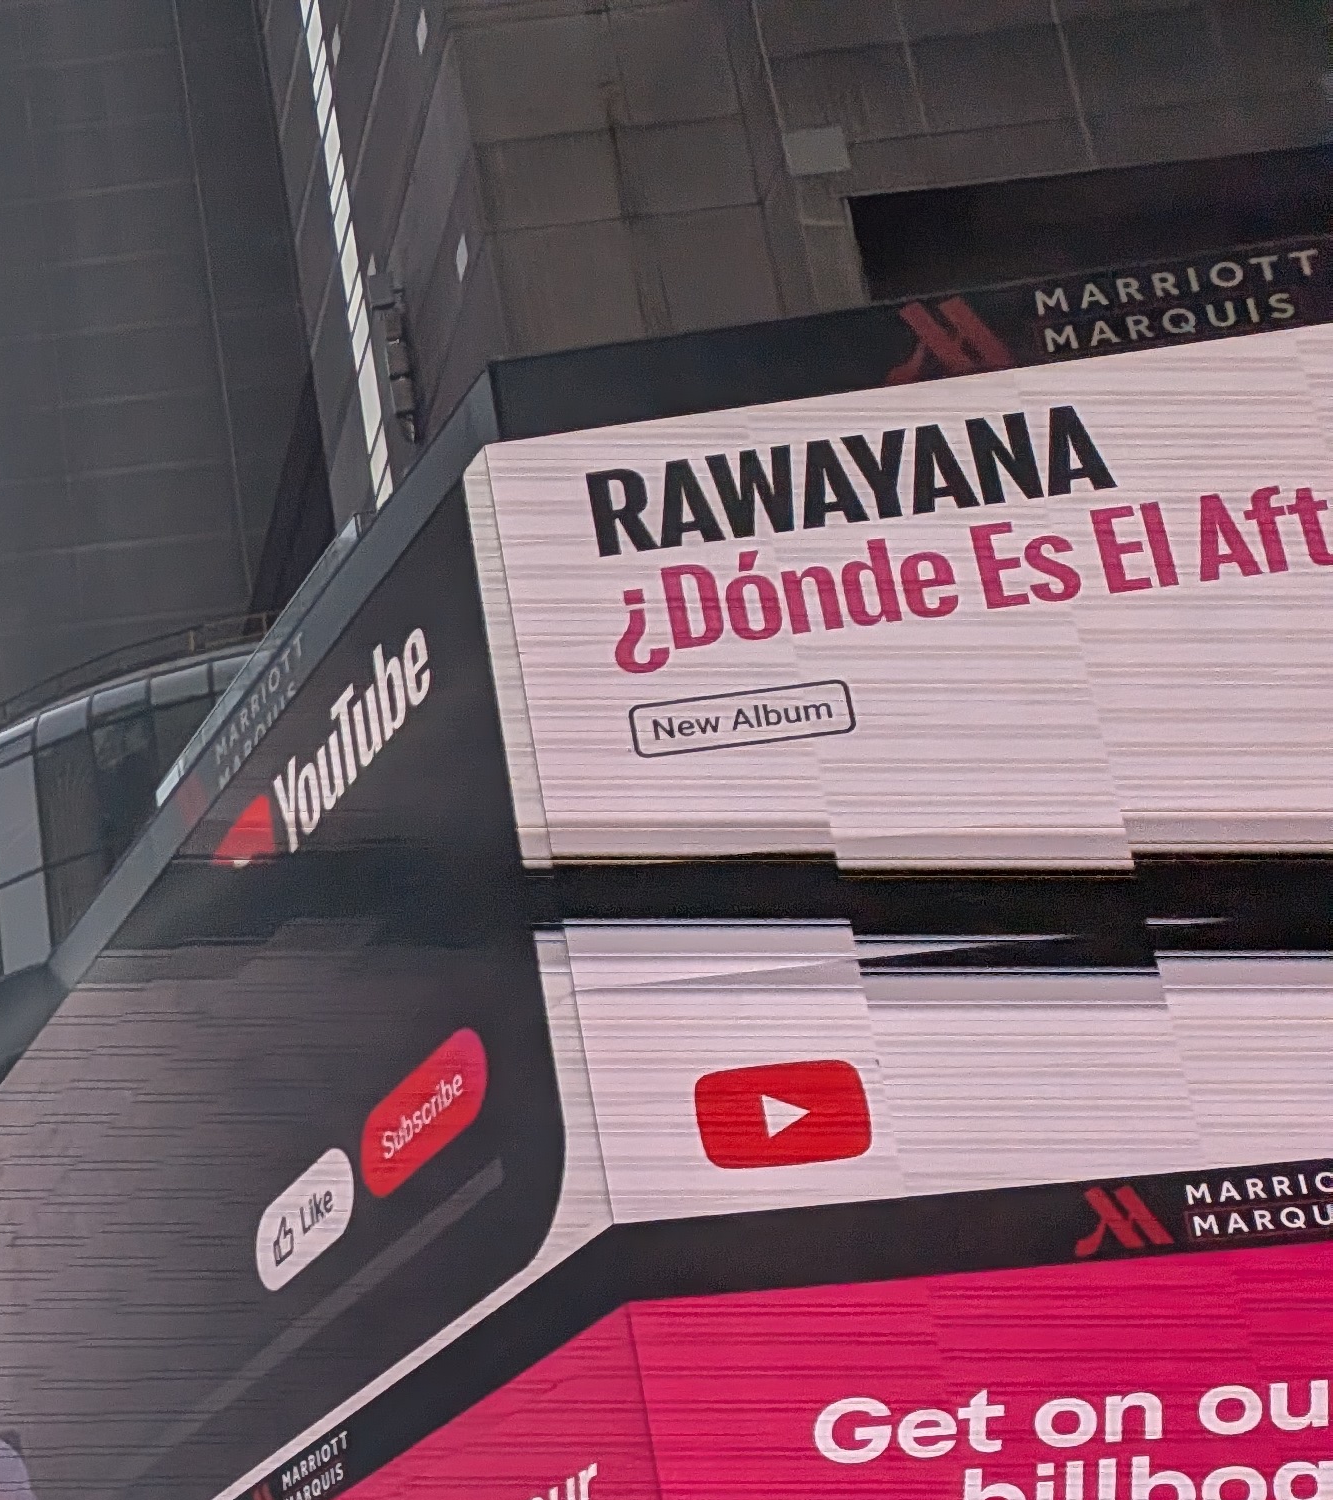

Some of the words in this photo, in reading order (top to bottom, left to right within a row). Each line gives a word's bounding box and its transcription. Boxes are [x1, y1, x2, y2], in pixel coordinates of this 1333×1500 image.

[1035, 248, 1318, 315] MARRIOTT
[1043, 292, 1296, 353] MARQUIS
[585, 405, 1118, 558] RAWAYANA
[614, 537, 960, 674] ¿Dónde
[969, 521, 1082, 609] Es
[1090, 502, 1179, 594] El
[216, 632, 302, 765] MARRIOTT
[652, 714, 721, 742] New
[732, 699, 833, 733] Album
[272, 625, 433, 853] YouTube
[380, 1071, 464, 1161] Subscribe
[299, 1186, 334, 1233] Like
[282, 1431, 348, 1491] MARRIOTT
[813, 1389, 1005, 1464] Get
[1034, 1392, 1162, 1447] on
